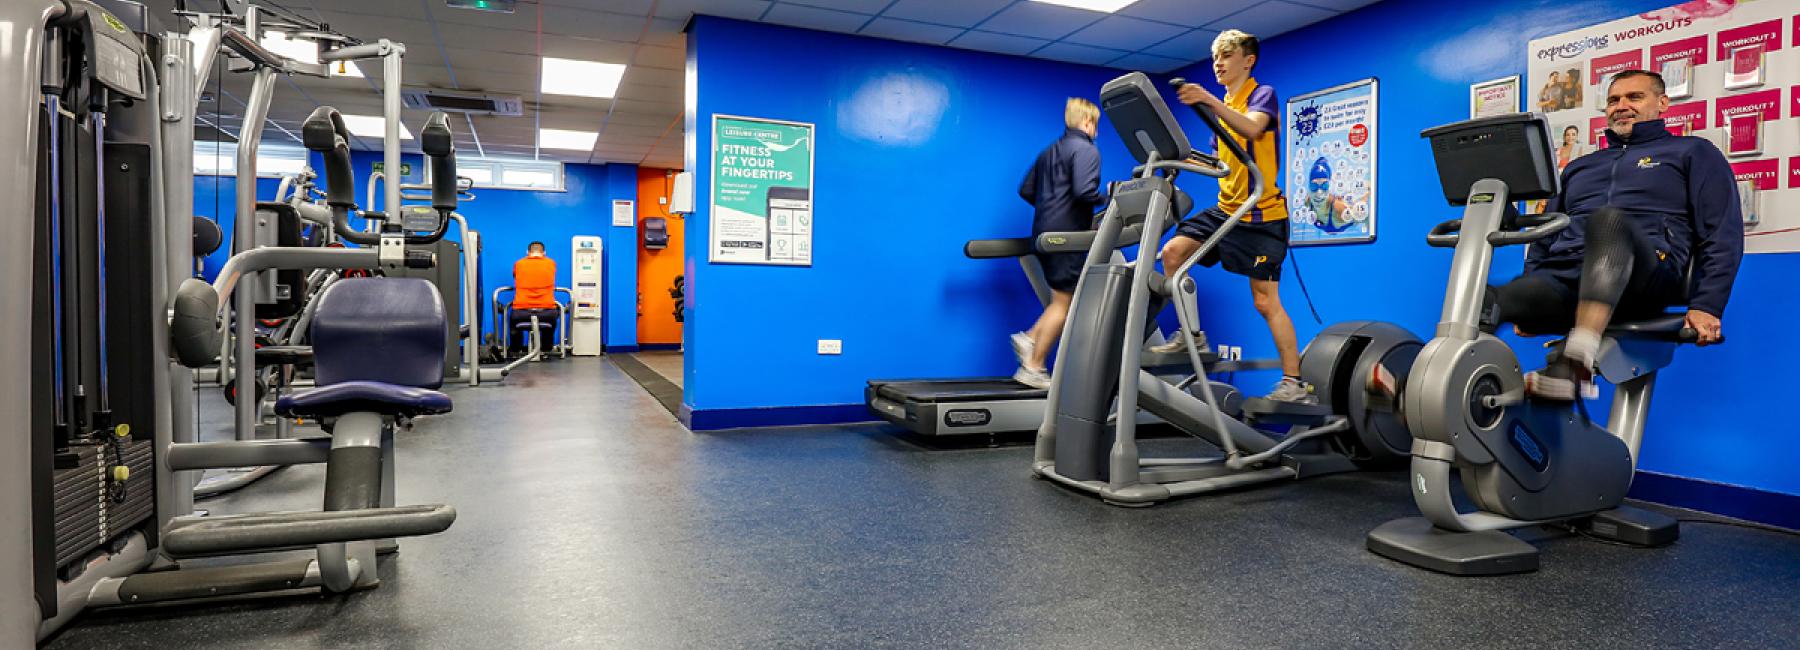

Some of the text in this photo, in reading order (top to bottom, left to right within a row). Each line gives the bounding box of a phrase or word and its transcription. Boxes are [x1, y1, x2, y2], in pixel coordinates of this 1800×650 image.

[1614, 16, 1692, 42] WORKOUTS
[1722, 34, 1769, 48] WORKOUT
[1655, 48, 1696, 62] WORKOUT
[1595, 62, 1633, 74] WORKOUT
[1721, 103, 1767, 115] WORKOUT
[1301, 120, 1314, 134] 23
[722, 144, 771, 157] FITNESS
[721, 155, 775, 169] AT YOUR
[721, 166, 793, 181] FINGERTIPS
